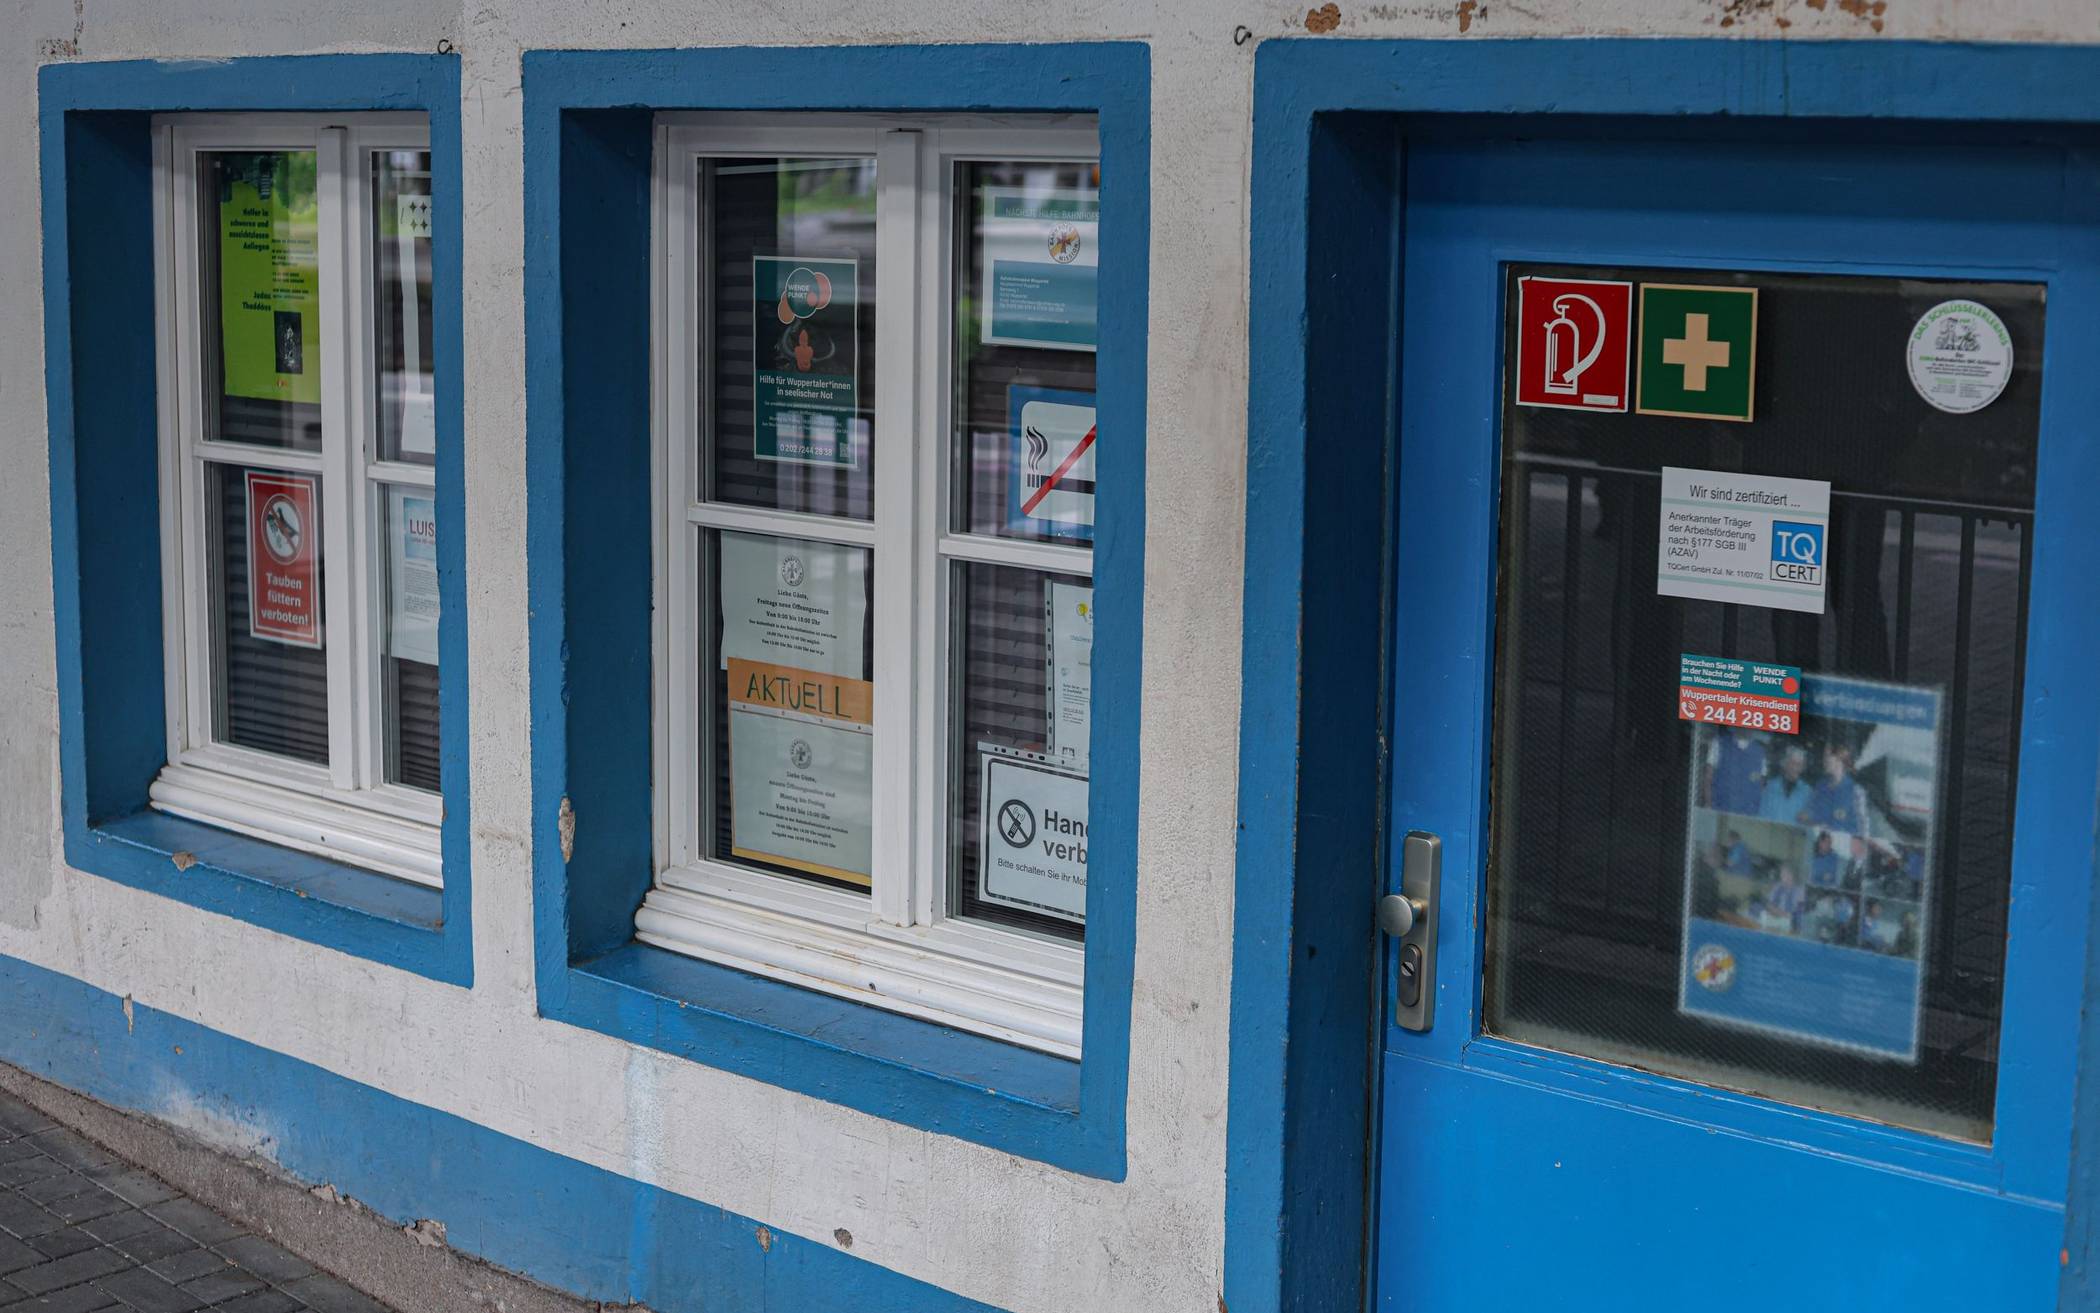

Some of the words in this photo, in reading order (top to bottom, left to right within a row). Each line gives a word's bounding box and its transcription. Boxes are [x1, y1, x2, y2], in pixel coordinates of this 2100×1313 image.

[257, 220, 269, 228] und
[788, 284, 810, 292] WENDE
[1913, 320, 1929, 340] DAS
[760, 375, 775, 385] Hilfe
[775, 376, 785, 385] für
[777, 386, 784, 396] in
[785, 388, 819, 399] seelischer
[820, 391, 833, 400] Not
[1690, 484, 1708, 498] Wir
[1710, 487, 1733, 501] sind
[1735, 490, 1787, 506] zertifiziert
[1669, 511, 1721, 525] Anerkannter
[1724, 516, 1752, 529] Träger
[1668, 524, 1682, 533] der
[1684, 525, 1756, 542] Arbeitsförderung
[1668, 536, 1689, 546] nach
[1691, 537, 1713, 548] §177
[1715, 539, 1736, 550] SGB
[1737, 541, 1747, 551] III
[1777, 531, 1816, 565] TQ
[1667, 546, 1699, 560] (AZAV)
[1667, 562, 1690, 572] TQCert
[1691, 565, 1711, 574] GmbH
[1775, 563, 1817, 582] CERT
[266, 572, 302, 590] Tauben
[267, 587, 301, 607] füttern
[261, 606, 309, 626] verboten!
[766, 610, 776, 619] Von
[1682, 658, 1715, 669] Brauchen
[1715, 662, 1727, 670] Sie
[1728, 664, 1745, 672] Hilfe
[1753, 666, 1788, 677] WENDE
[1689, 667, 1701, 676] der
[1702, 669, 1723, 678] Nacht
[1723, 671, 1740, 680] oder
[1693, 675, 1742, 688] Wochenende?
[1753, 675, 1783, 685] PUNKT
[746, 672, 852, 719] AKTUELL
[1681, 688, 1738, 704] Wuppertaler
[1739, 696, 1798, 712] Krisendienst
[1703, 705, 1737, 724] 244
[1742, 710, 1764, 728] 28
[1769, 714, 1792, 731] 38
[998, 857, 1014, 869] Bitte
[1015, 862, 1046, 877] schalten
[1047, 869, 1060, 880] Sie
